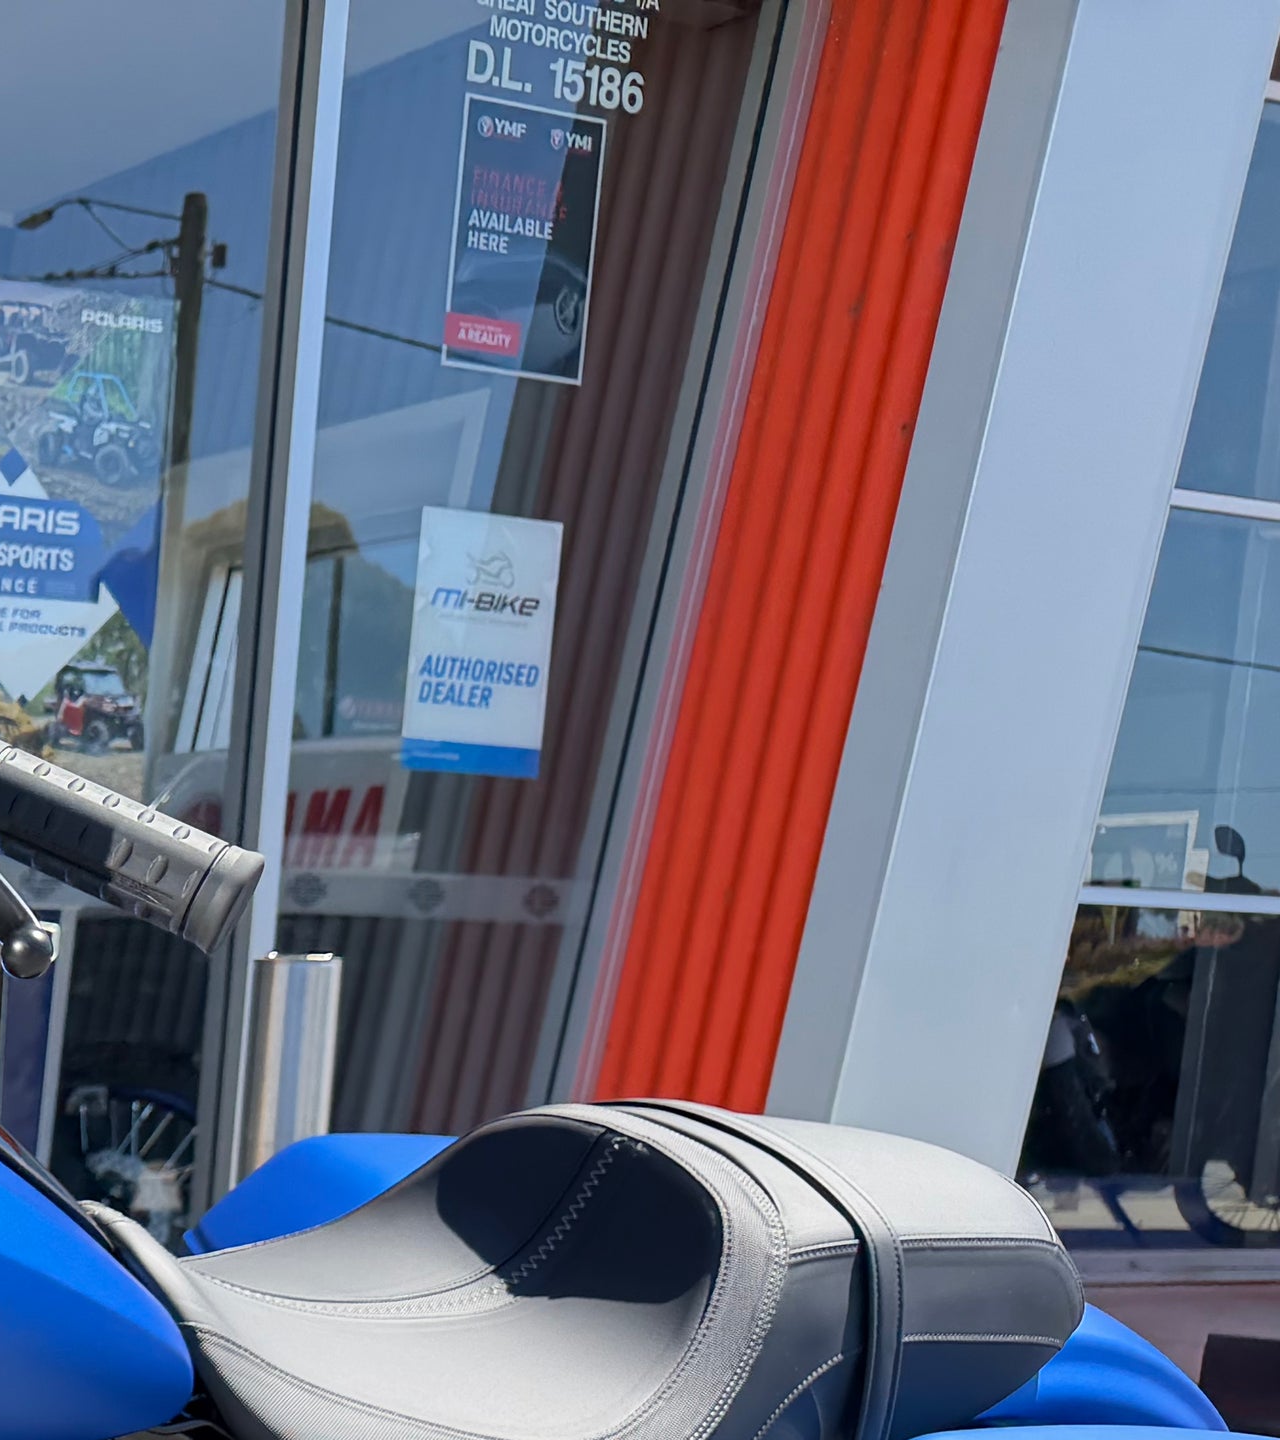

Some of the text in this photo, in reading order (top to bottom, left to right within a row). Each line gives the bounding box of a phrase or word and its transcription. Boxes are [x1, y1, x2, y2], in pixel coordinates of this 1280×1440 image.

[544, 0, 649, 39] SOUTHERN
[490, 15, 631, 64] MOTORCYCLES
[466, 40, 645, 114] D.L. 15186
[494, 118, 527, 138] YMF
[565, 132, 592, 152] YMI
[468, 208, 554, 240] AVAILABLE
[467, 231, 509, 254] HERE
[80, 308, 164, 334] POLARIS
[12, 607, 42, 620] FOR
[8, 620, 87, 638] PRODUCTS
[419, 654, 539, 688] AUTHORISED
[418, 681, 493, 710] DEALER
